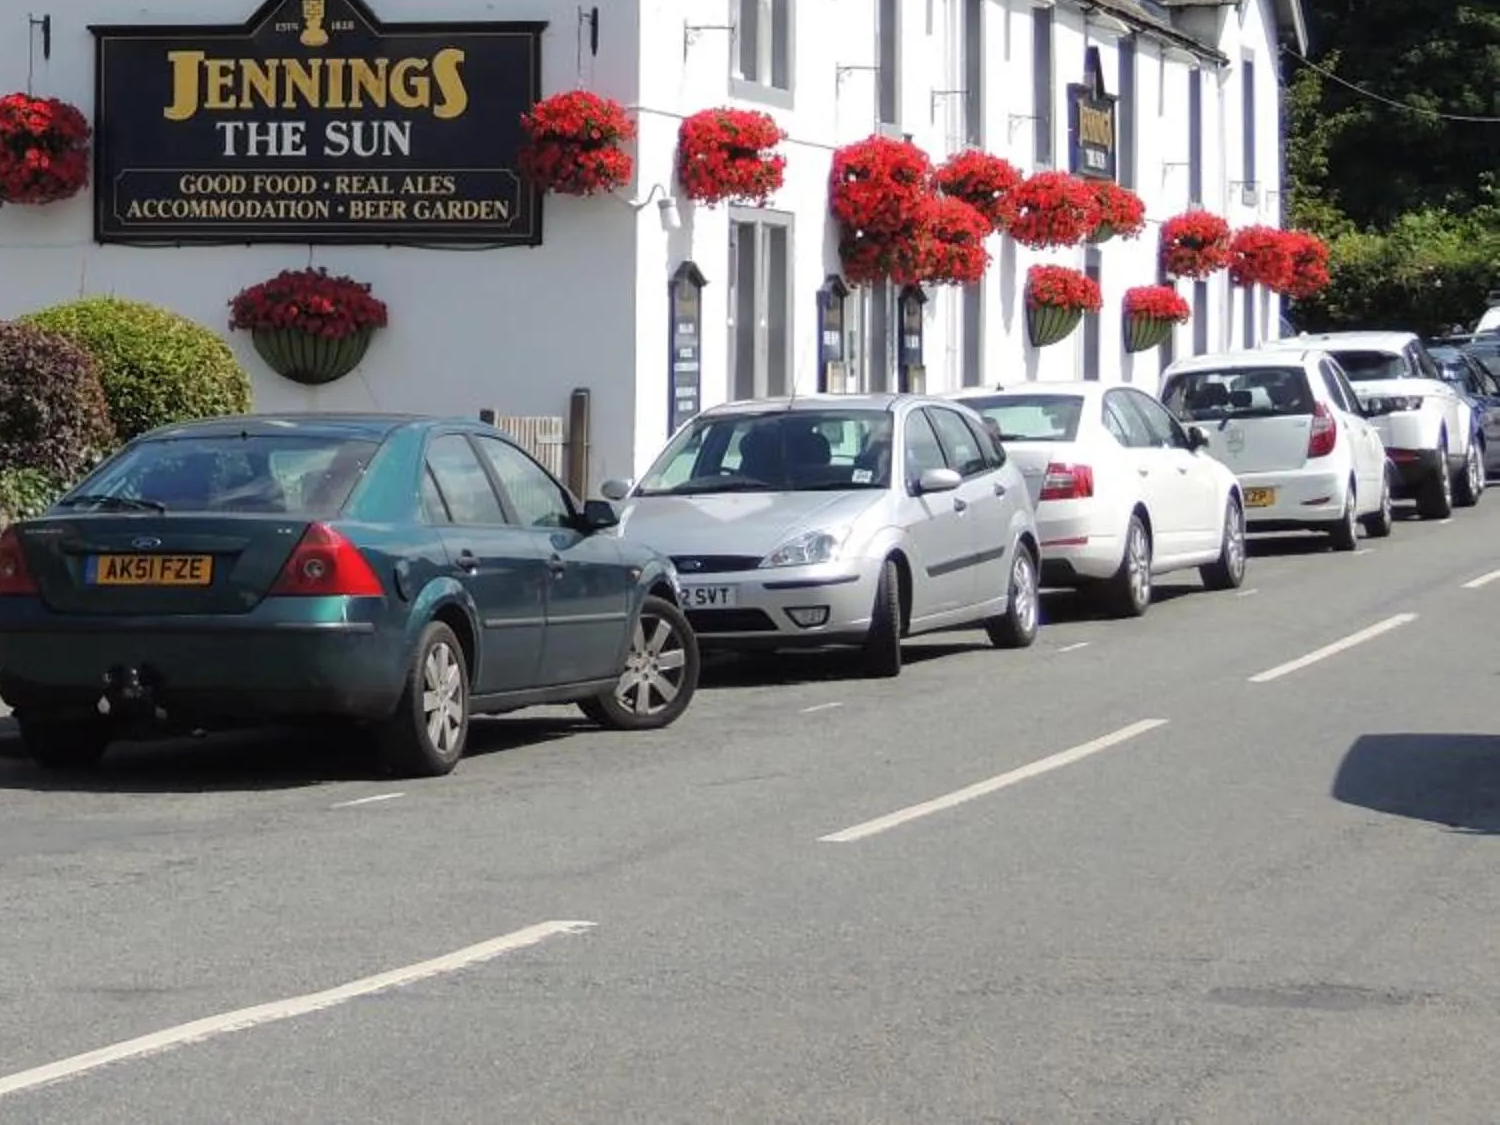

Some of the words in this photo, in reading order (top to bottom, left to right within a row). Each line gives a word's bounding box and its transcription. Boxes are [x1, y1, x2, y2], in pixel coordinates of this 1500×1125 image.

[163, 48, 468, 120] JENNINGS
[216, 121, 307, 156] THE
[323, 120, 412, 157] SUN
[179, 174, 247, 194] GOOD
[252, 175, 317, 194] FOOD
[335, 175, 395, 194] REAL
[400, 176, 456, 194] ALES
[126, 199, 330, 219] ACCOMMODATION
[349, 200, 407, 219] BEER
[413, 200, 509, 220] GARDEN
[105, 558, 154, 580] AK51
[160, 558, 204, 580] FZE
[695, 587, 729, 605] SVT
